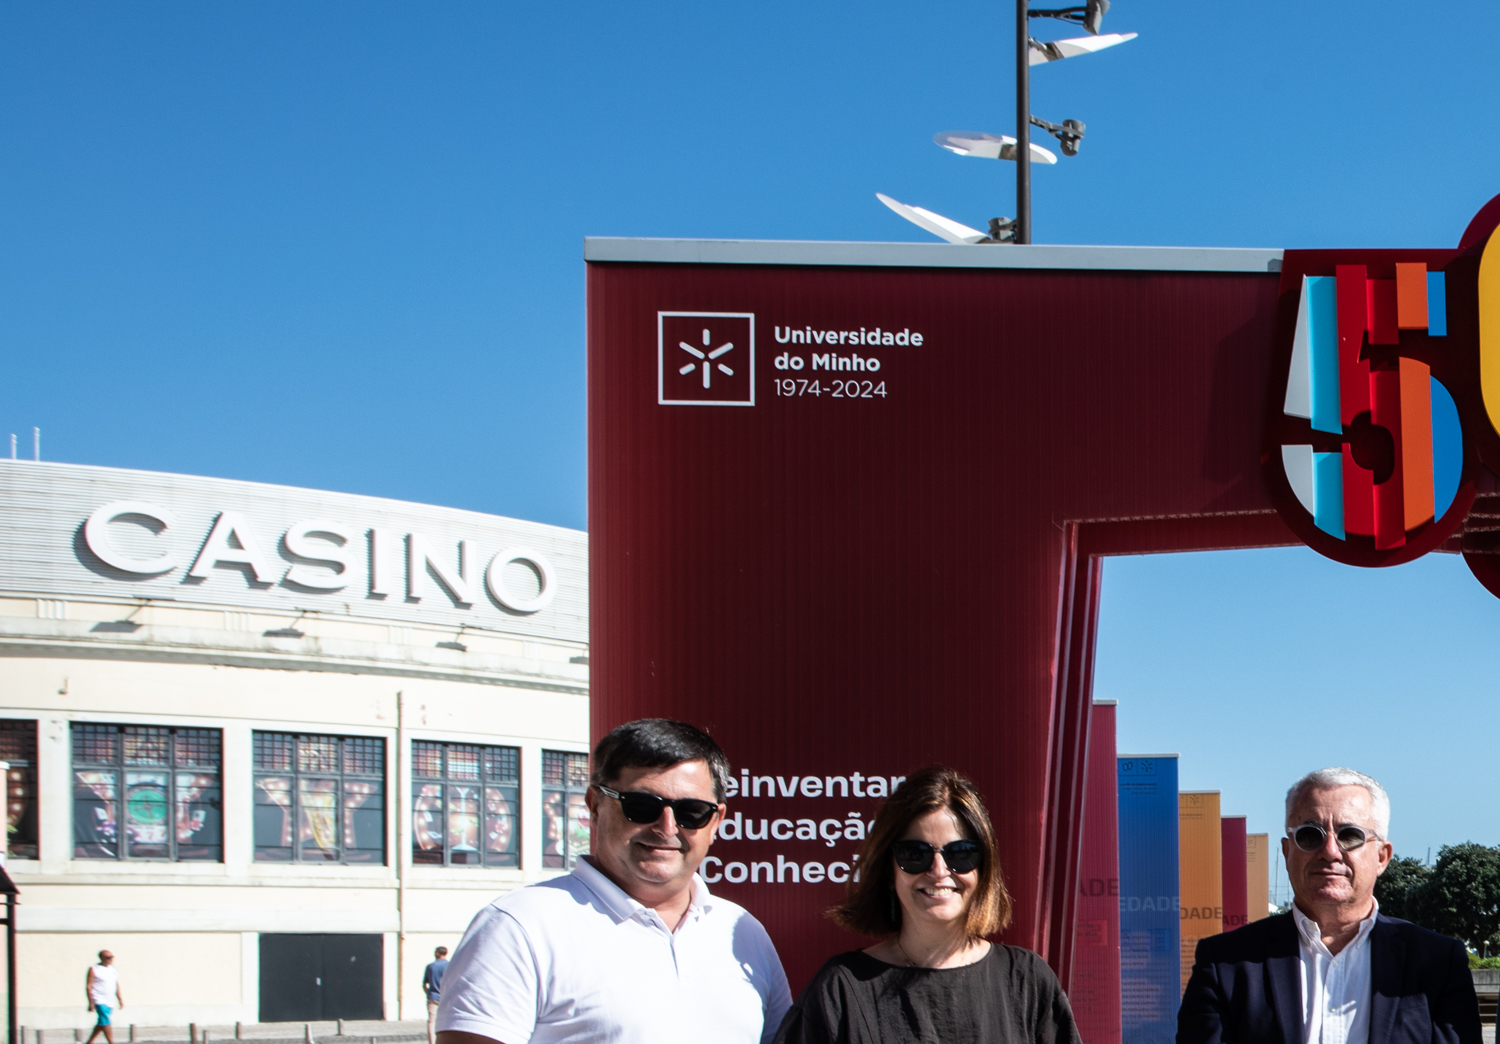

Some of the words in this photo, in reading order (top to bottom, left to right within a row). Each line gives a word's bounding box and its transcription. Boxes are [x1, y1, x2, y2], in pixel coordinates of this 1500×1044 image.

[774, 326, 924, 347] Universidade
[774, 352, 804, 370] do
[812, 353, 881, 372] Minho
[774, 379, 887, 398] 1974-2024
[84, 500, 557, 613] CASINO
[713, 811, 876, 848] ducaçã
